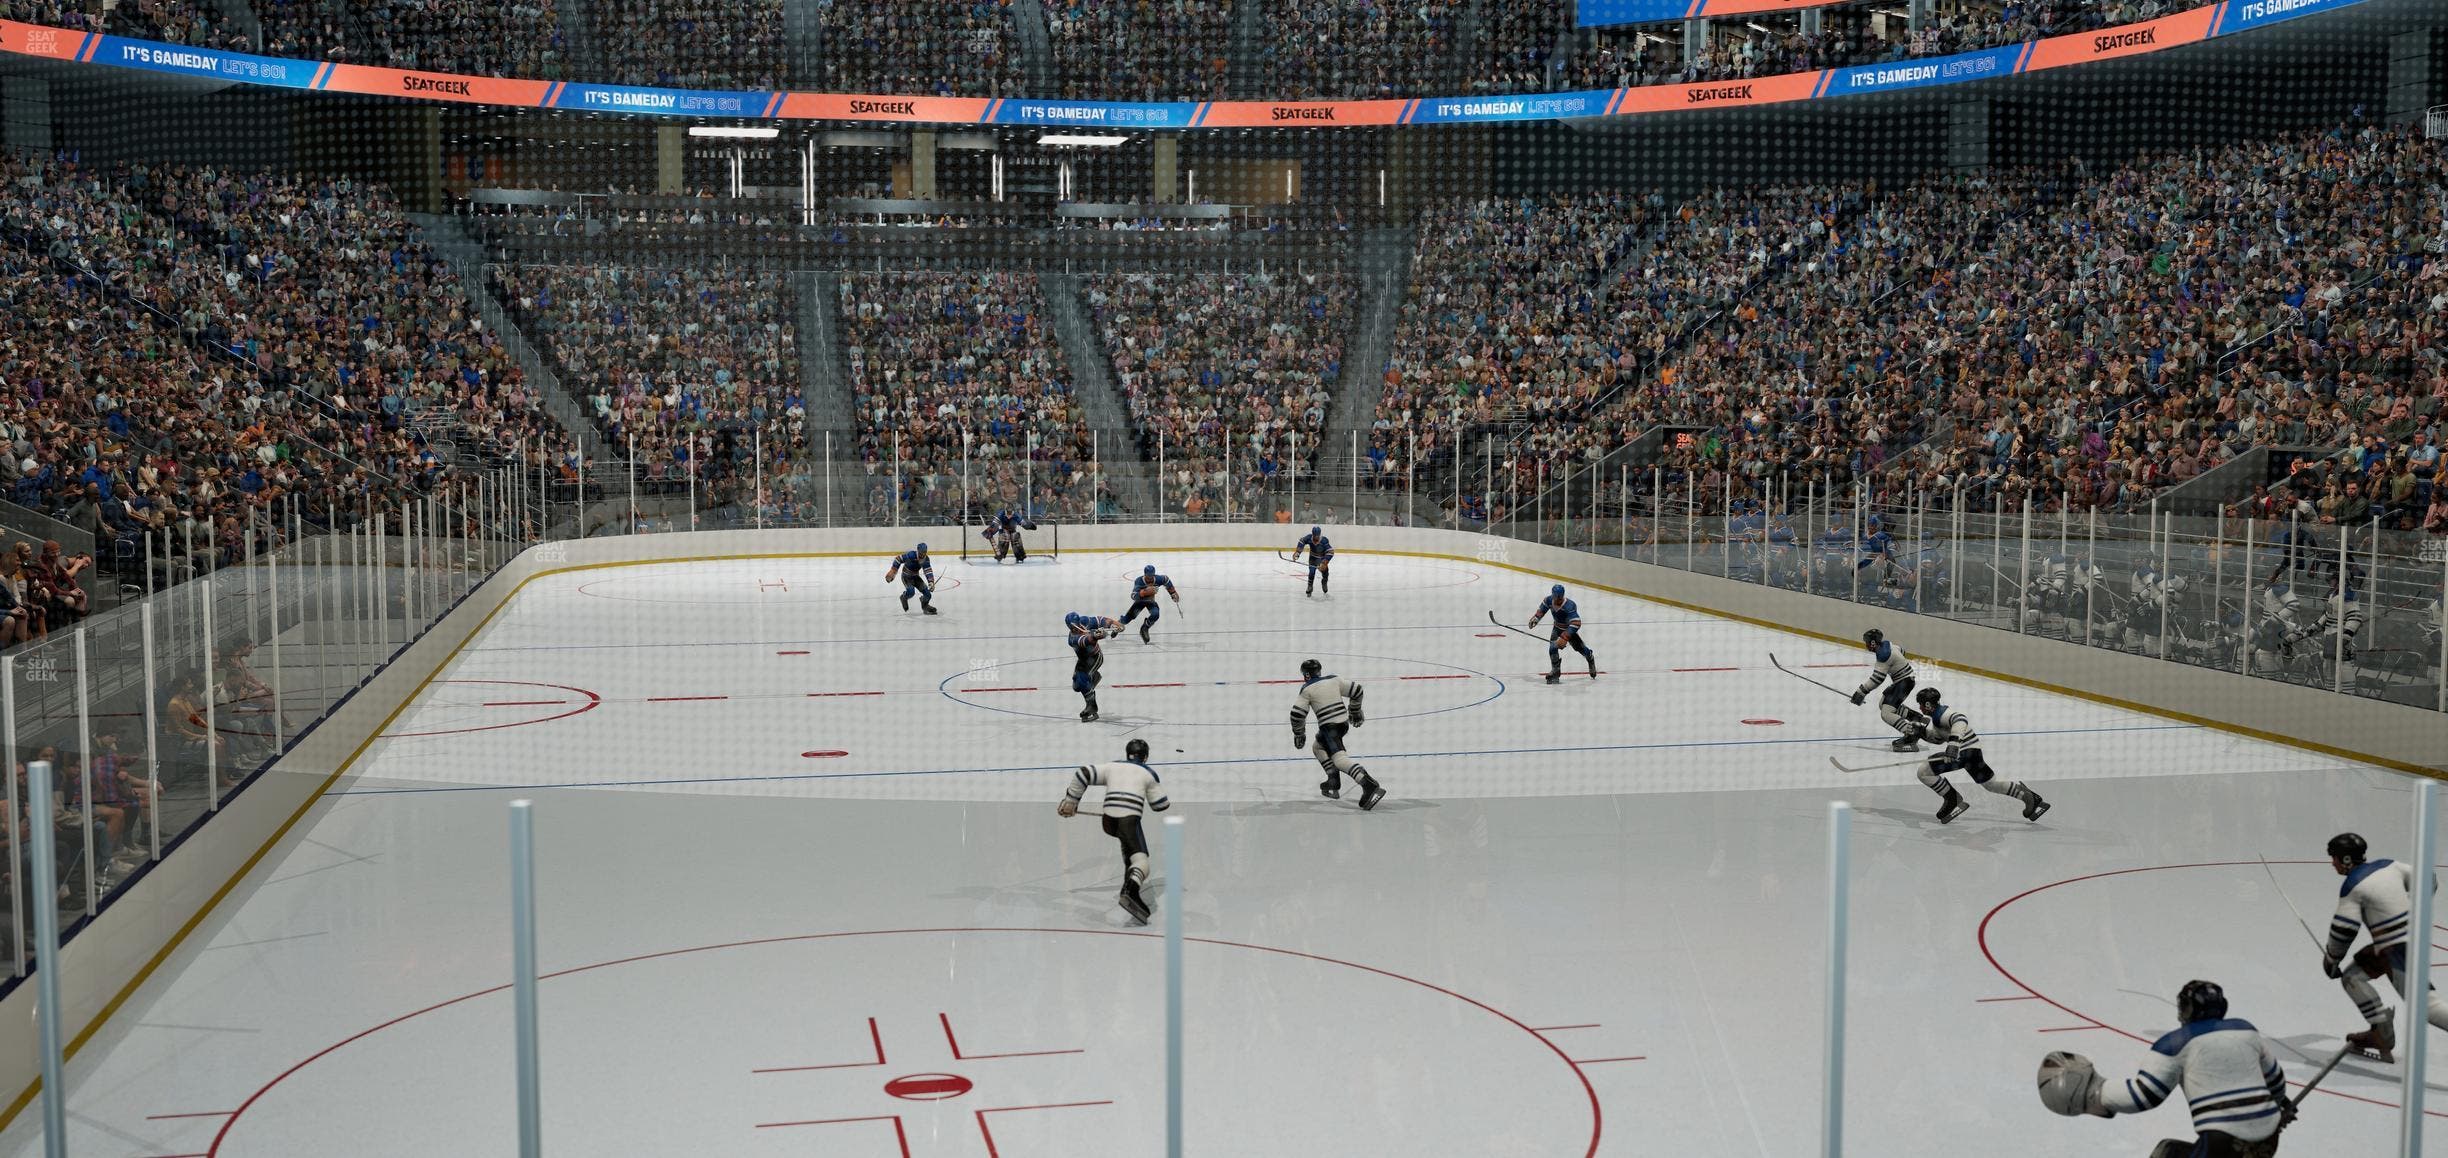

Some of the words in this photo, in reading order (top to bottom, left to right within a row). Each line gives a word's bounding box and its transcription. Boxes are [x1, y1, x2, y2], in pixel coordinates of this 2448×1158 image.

[2242, 3, 2264, 21] IT'S
[2266, 0, 2331, 15] GAME
[2094, 27, 2155, 53] SEATGEEK
[123, 46, 149, 62] IT'S
[153, 51, 218, 70] GAMEDAY
[222, 59, 258, 76] LET'S
[260, 63, 286, 79] GO!
[1851, 73, 1875, 87] IT'S
[1878, 65, 1938, 84] GAMEDAY
[1942, 61, 1974, 77] LET'S
[1976, 56, 1996, 73] GO!
[403, 76, 470, 96] SEATGEEK
[1688, 85, 1752, 103] SEATGEEK
[585, 90, 609, 104] IT'S
[613, 93, 675, 109] GAMEDAY
[679, 97, 715, 111] LET'S
[718, 98, 740, 111] GO!
[850, 100, 915, 115] SEATGEEK
[1438, 104, 1461, 117] IT'S
[1464, 102, 1524, 116] GAMEDAY
[1528, 99, 1562, 114] LET'S
[1564, 98, 1585, 112] GO!
[1022, 106, 1044, 118] IT'S
[1047, 107, 1106, 120] GAMEDAY
[1111, 108, 1144, 121] LET'S
[1272, 107, 1335, 120] SEATGEEK
